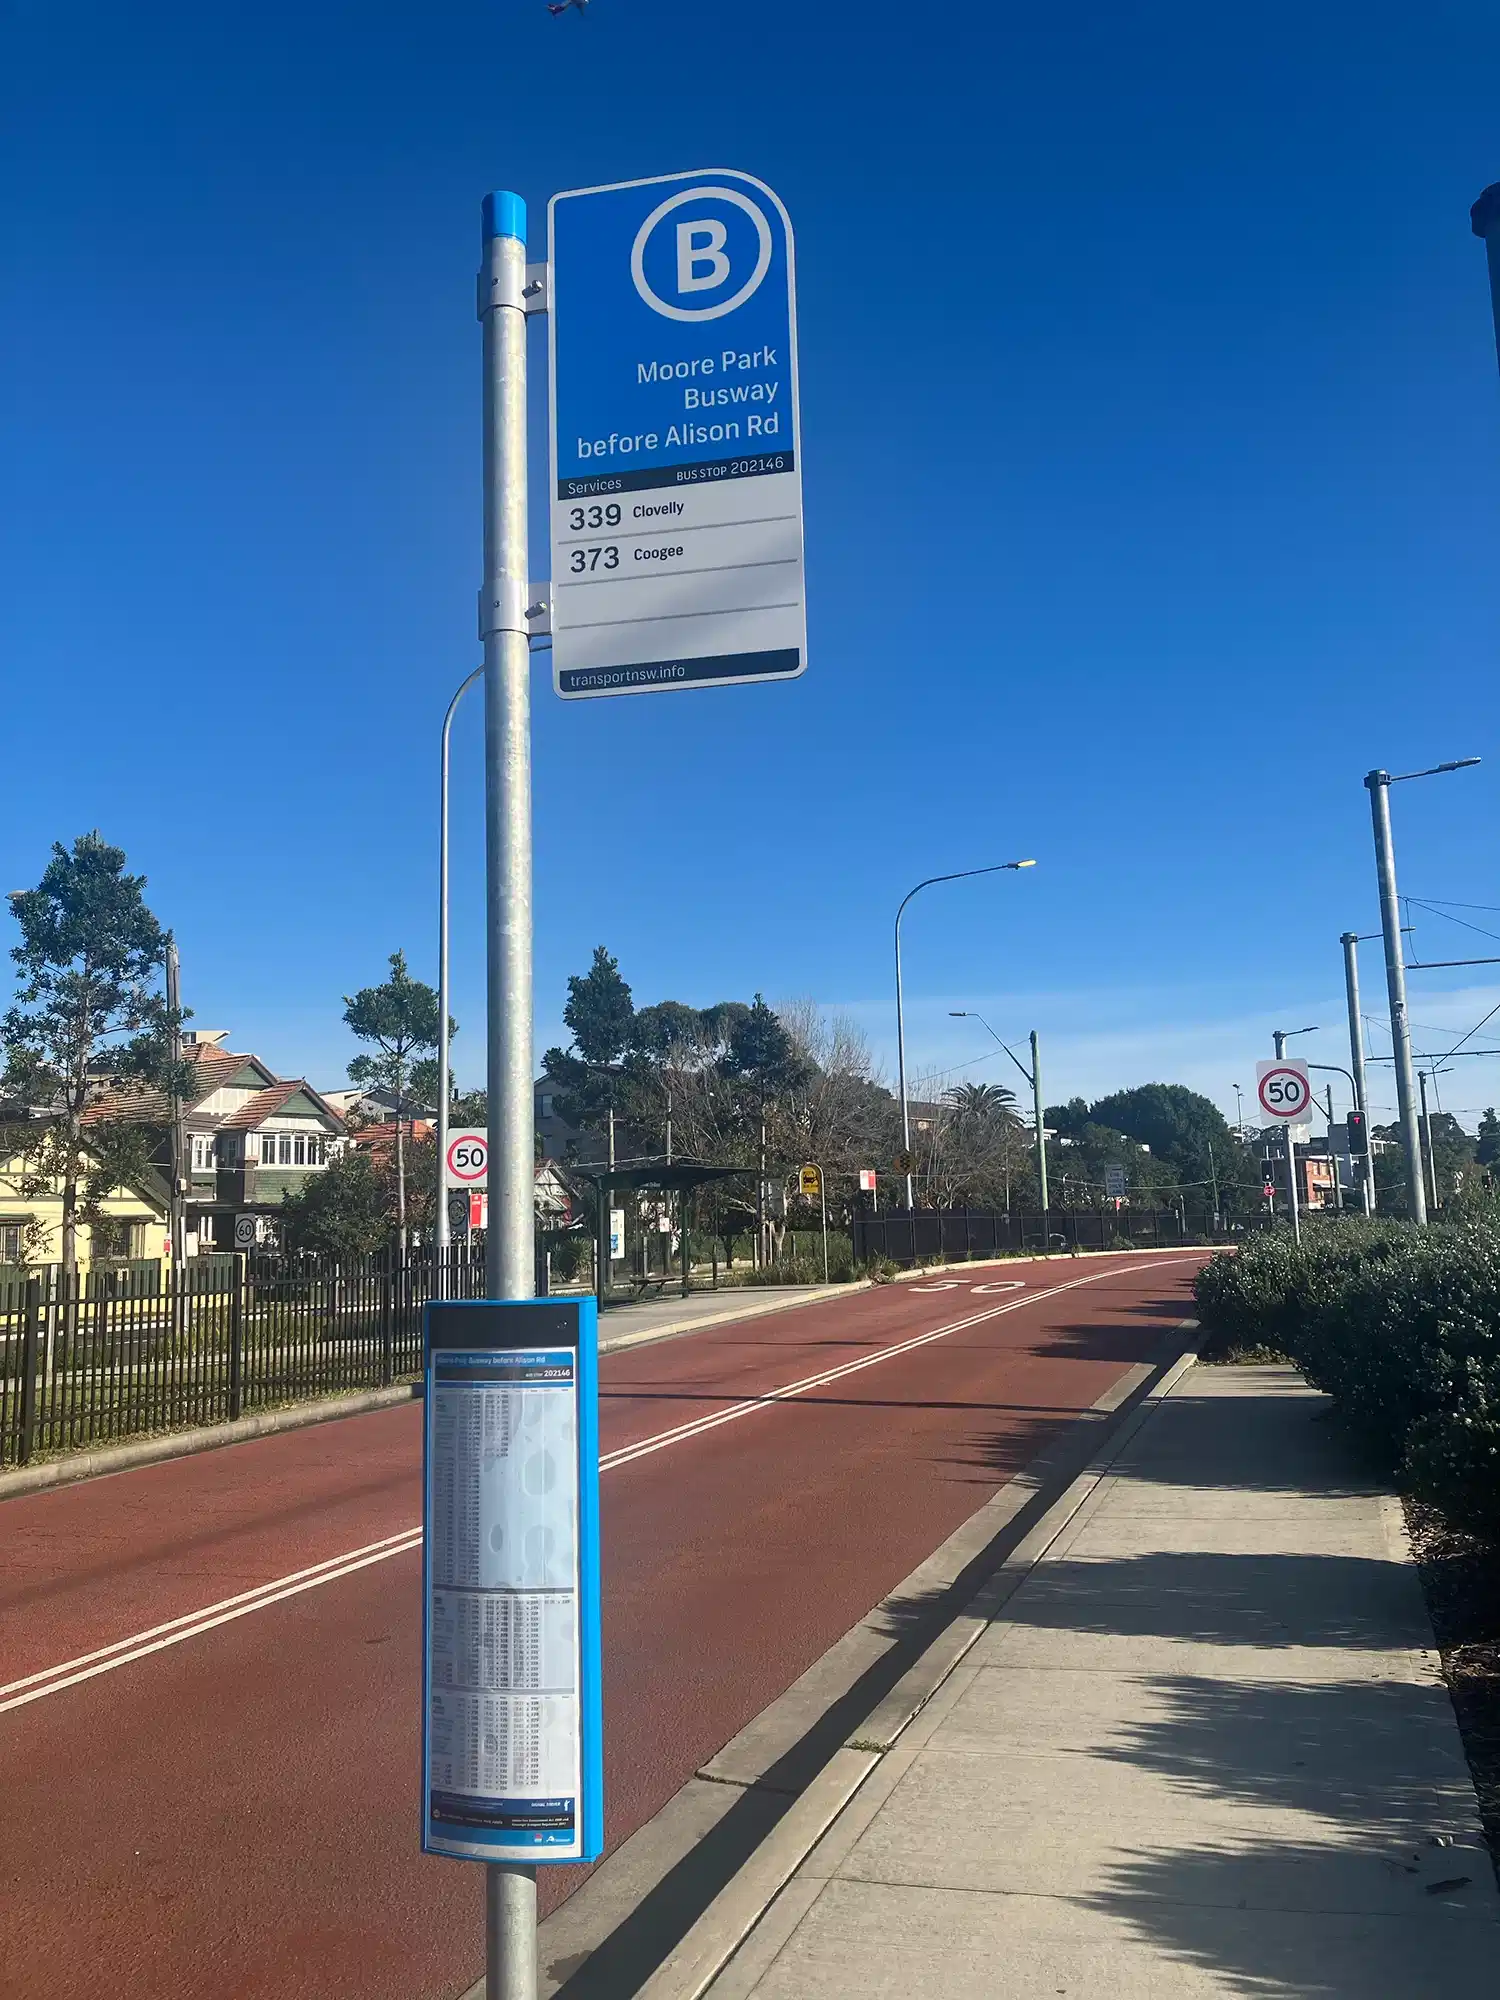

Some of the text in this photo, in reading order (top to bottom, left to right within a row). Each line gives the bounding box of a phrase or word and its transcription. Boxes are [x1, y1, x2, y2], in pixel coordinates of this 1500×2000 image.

[676, 219, 730, 293] B
[637, 346, 777, 384] Moore Park
[684, 381, 779, 409] Busway
[577, 412, 779, 459] before Alison Rd
[676, 456, 784, 481] BUS STOP 202146
[567, 477, 622, 495] Services
[569, 501, 685, 531] 339 Clovelly
[570, 544, 684, 573] 373 Coogee
[570, 664, 685, 688] transportnsw.info
[1268, 1081, 1300, 1103] 50
[456, 1147, 484, 1167] 50
[239, 1224, 251, 1236] 60
[908, 1279, 1026, 1294] 50
[543, 1368, 571, 1377] 202146
